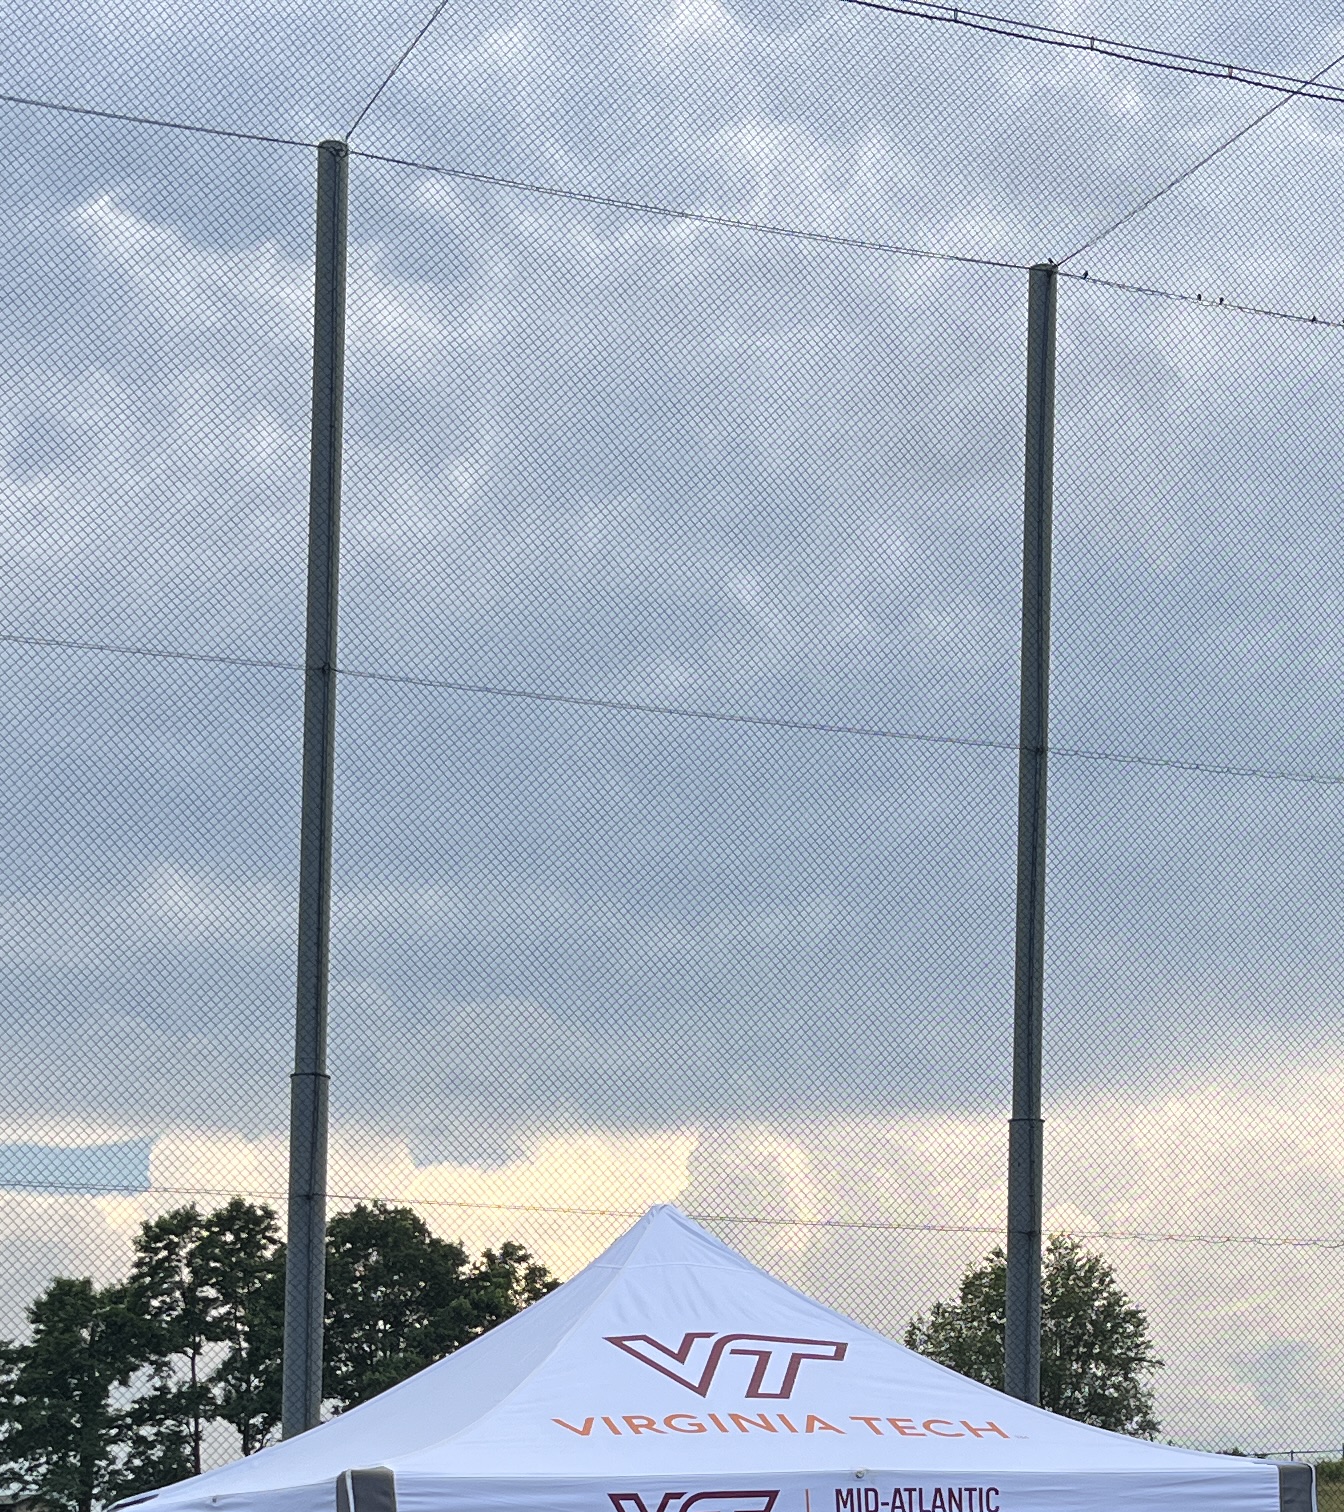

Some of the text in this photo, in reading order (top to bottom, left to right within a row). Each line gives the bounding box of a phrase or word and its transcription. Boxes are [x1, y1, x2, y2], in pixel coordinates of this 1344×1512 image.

[602, 1332, 848, 1399] VT
[550, 1413, 1011, 1439] VIRGINIA TECH
